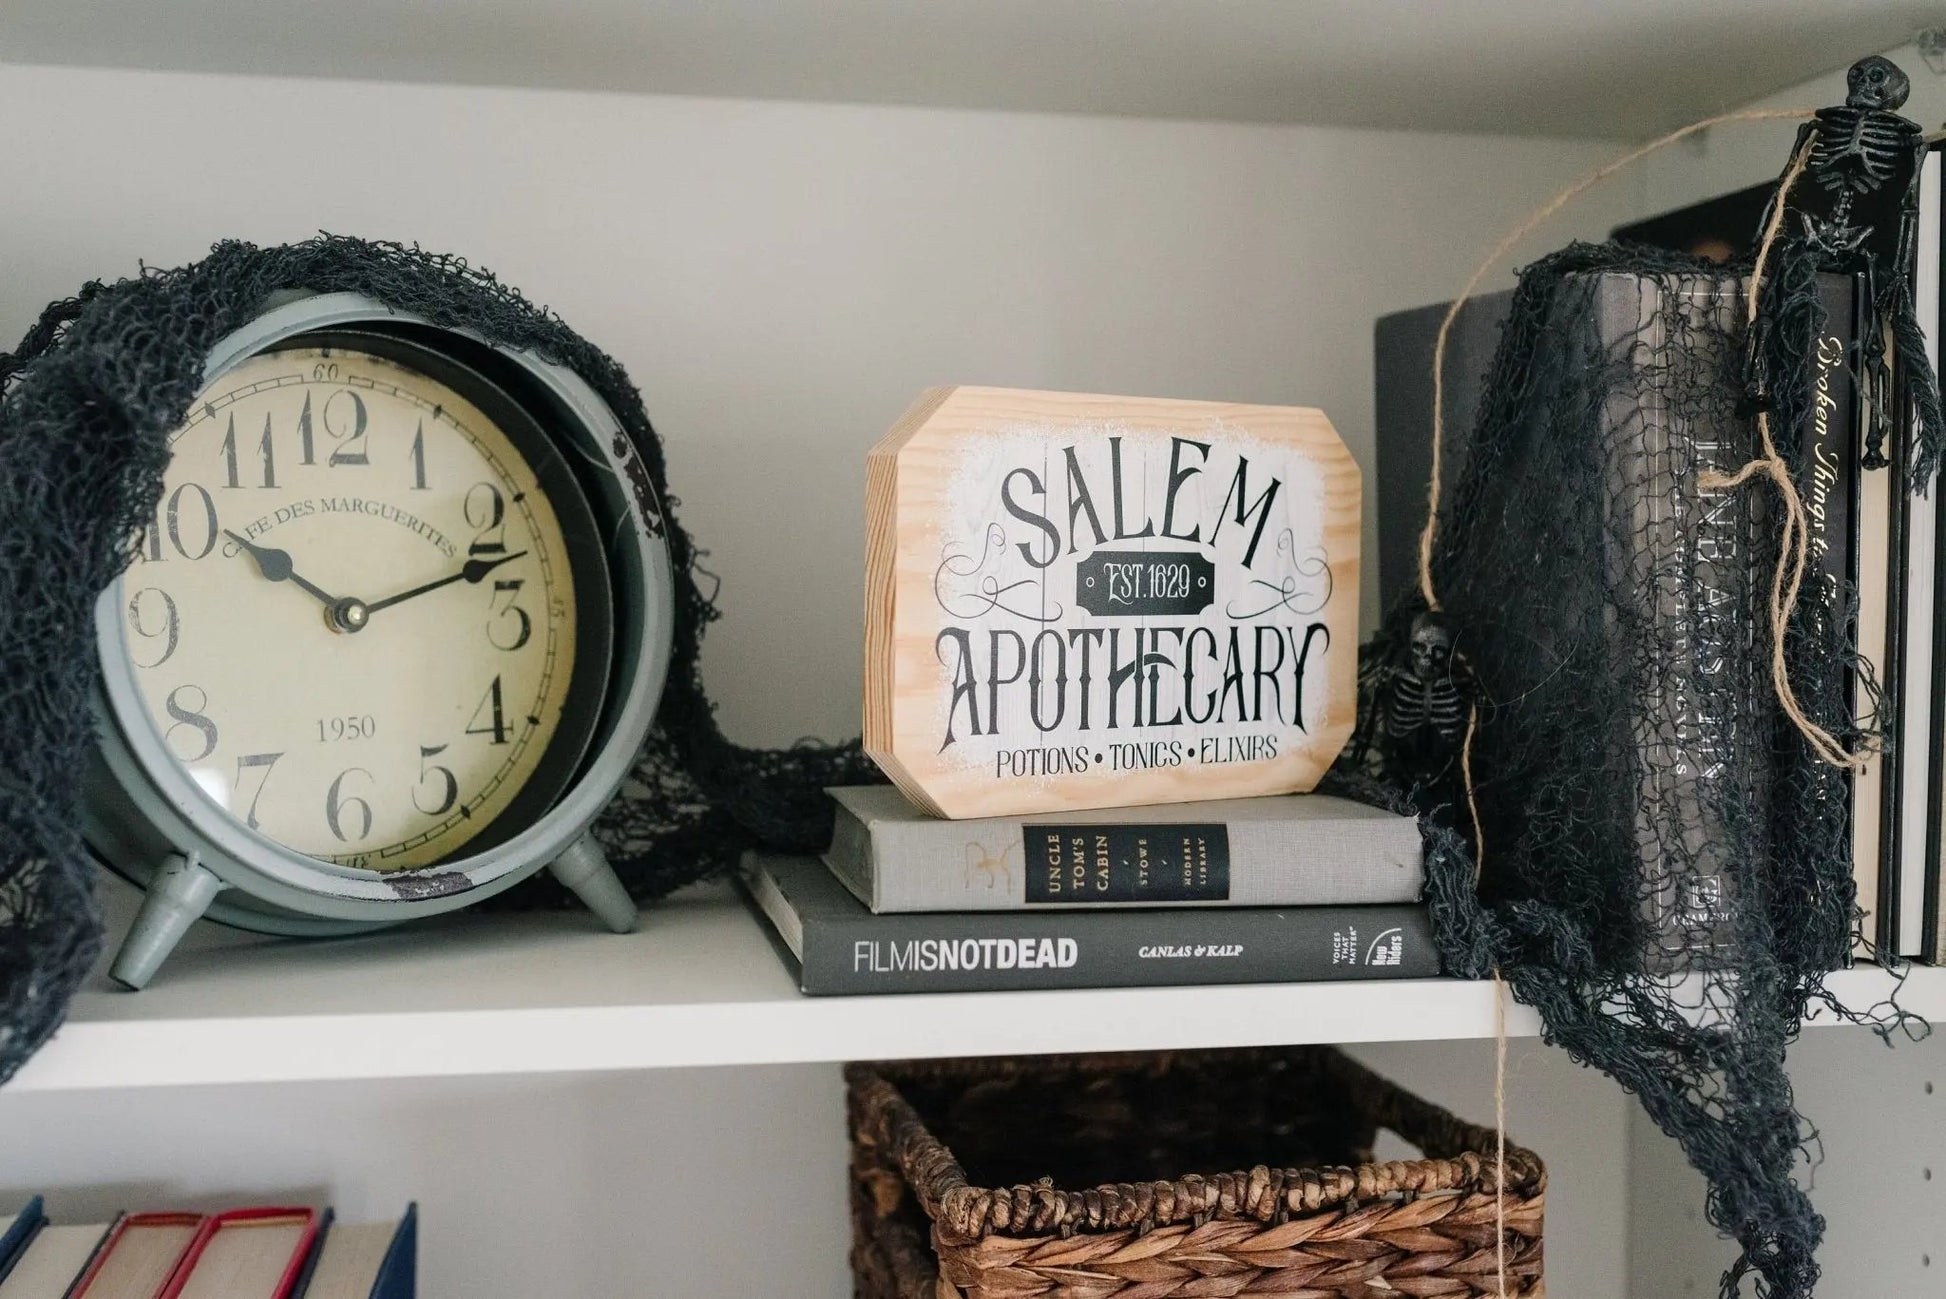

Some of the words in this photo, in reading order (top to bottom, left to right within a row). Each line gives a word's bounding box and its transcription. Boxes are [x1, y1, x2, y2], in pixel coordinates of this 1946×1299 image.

[312, 363, 339, 382] 60
[1813, 336, 1843, 436] Broken
[220, 410, 282, 489] 11
[298, 389, 370, 467] 12
[408, 417, 432, 490] 1
[464, 481, 507, 556] 2
[1000, 436, 1282, 569] SALEM
[1805, 441, 1840, 531] Things
[143, 482, 218, 562] 10
[222, 517, 273, 558] CFE
[274, 499, 316, 526] DES
[320, 498, 458, 558] MARGUERITES
[129, 587, 181, 668] 9
[485, 579, 531, 651] 3
[465, 674, 515, 745] 4
[935, 622, 1330, 756] APOTHECARY
[165, 685, 219, 763] 8
[315, 714, 376, 743] 1950
[996, 745, 1090, 779] POTIONS
[1109, 739, 1183, 770] TONICS
[1200, 734, 1278, 764] ELIXIRS
[232, 751, 286, 832] 7
[325, 767, 376, 842] 6
[410, 744, 458, 816] 5
[1048, 834, 1062, 893] UNCLE
[1072, 837, 1085, 890] TOM'S
[1096, 835, 1109, 892] CABIN
[1139, 838, 1149, 886] STOWE
[1183, 838, 1192, 886] MODERN
[1198, 837, 1207, 885] LIBRARY
[854, 938, 1078, 972] FILMISNOTDEAD
[1138, 946, 1192, 958] CANLAS
[1194, 945, 1206, 957] &
[1206, 945, 1244, 957] KALP
[1333, 931, 1341, 965] VOICES
[1341, 936, 1349, 960] THAT
[1372, 945, 1387, 966] New
[1387, 935, 1402, 966] Riders
